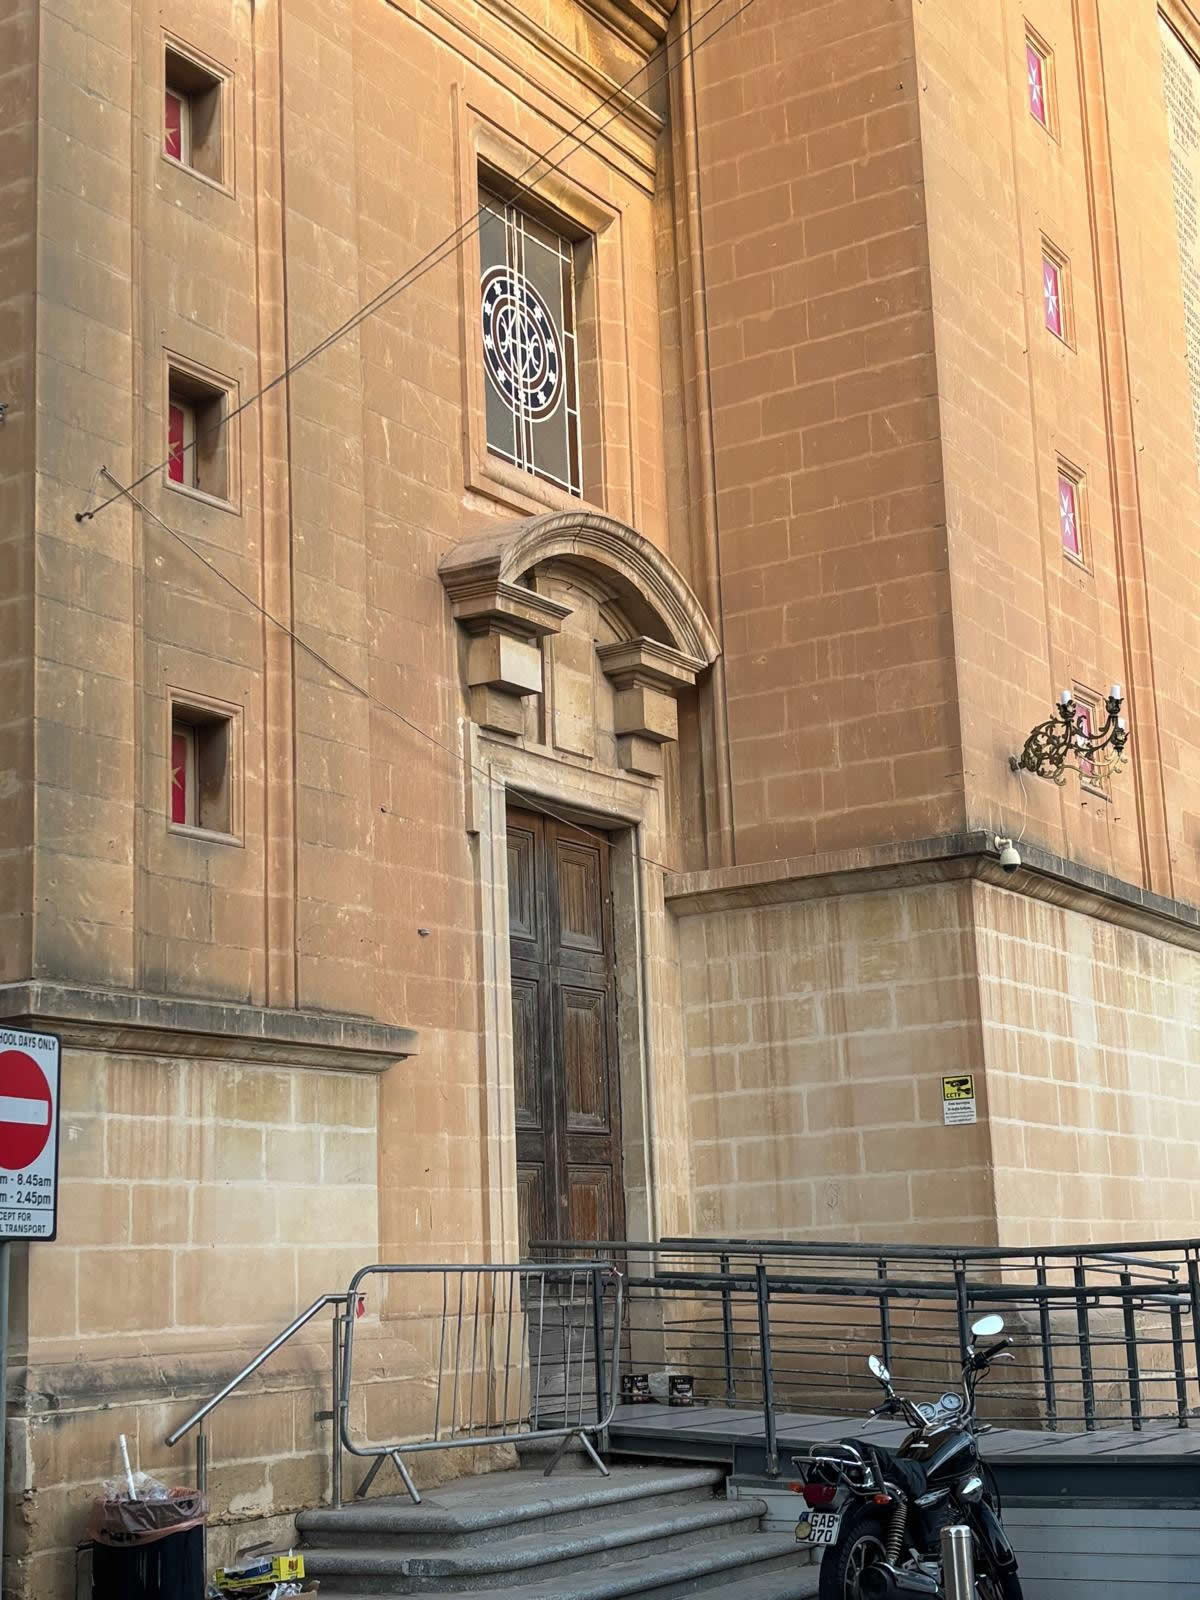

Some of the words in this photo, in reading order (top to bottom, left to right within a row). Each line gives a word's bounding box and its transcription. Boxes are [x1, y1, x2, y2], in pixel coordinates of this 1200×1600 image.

[19, 1035, 36, 1048] DAYS
[38, 1038, 56, 1050] ONLY
[17, 1174, 51, 1186] 8.45am
[16, 1191, 51, 1206] 2.45pm
[18, 1213, 31, 1221] FOR
[5, 1224, 46, 1233] TRANSPORT
[811, 1514, 835, 1528] GAB
